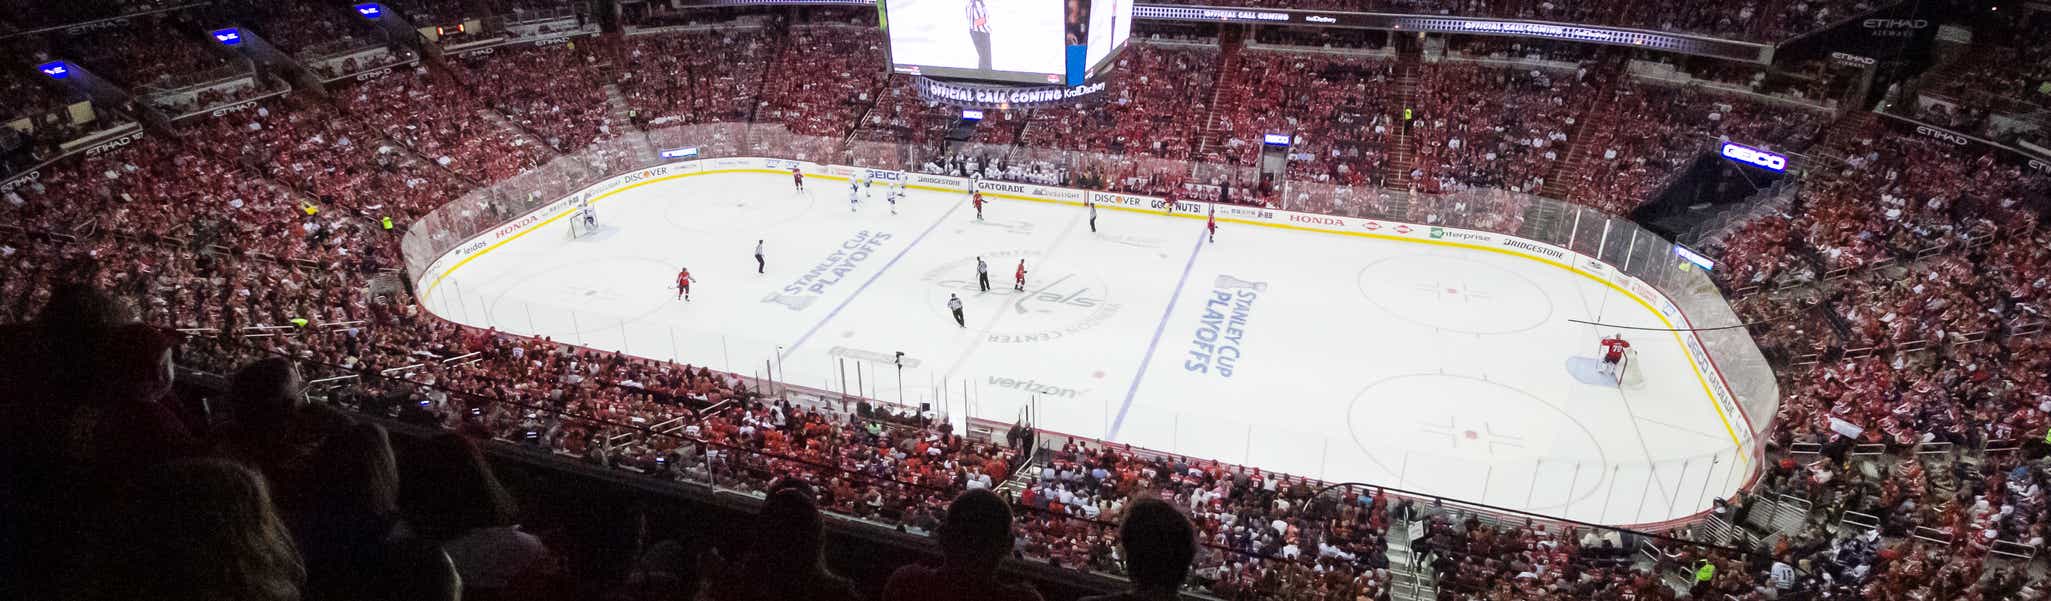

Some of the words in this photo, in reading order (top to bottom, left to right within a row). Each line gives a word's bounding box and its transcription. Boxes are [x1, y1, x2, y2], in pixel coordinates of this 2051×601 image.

[1204, 9, 1236, 18] OFFICIAL
[1238, 11, 1257, 19] CALL
[1258, 13, 1289, 21] COMING
[1863, 18, 1928, 29] ETIHAD
[1831, 51, 1876, 65] ETIHAD
[930, 84, 975, 102] OFFICIAL
[976, 89, 1008, 103] CALL
[1010, 88, 1062, 103] COMING
[86, 136, 131, 155] ETIHAD
[1916, 125, 1968, 146] ETIHAD
[1722, 143, 1786, 170] GEICO
[0, 170, 40, 194] ETIHAD
[624, 166, 669, 184] DISCOVER
[978, 181, 1024, 194] GATORADE
[1094, 193, 1141, 206] DISCOVER
[1175, 201, 1202, 213] NUTS!
[495, 215, 539, 239] HONDA
[1290, 214, 1345, 227] HONDA
[1503, 238, 1564, 259] BRIDGESTONE
[783, 249, 844, 295] STANLEY
[843, 230, 870, 250] CUP
[807, 231, 893, 294] PLAYOFFS
[1223, 290, 1256, 346] STANLEY
[1184, 289, 1233, 375] PLAYOFFS
[1215, 345, 1241, 378] CUP
[1687, 333, 1709, 374] GEICO
[988, 375, 1077, 399] verizon
[1708, 370, 1736, 418] GATORADE
